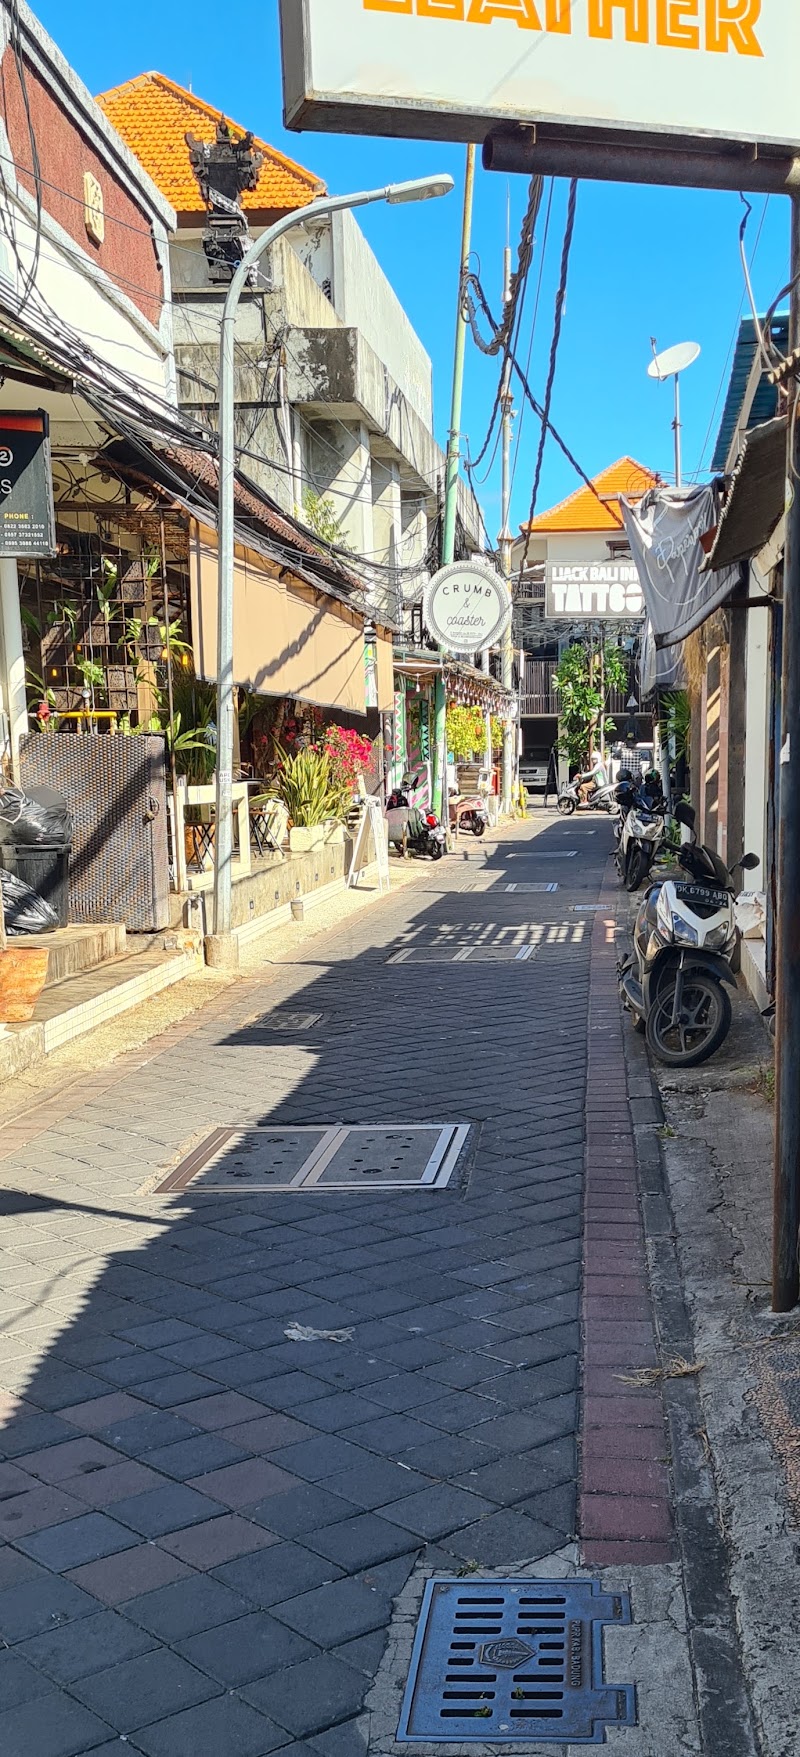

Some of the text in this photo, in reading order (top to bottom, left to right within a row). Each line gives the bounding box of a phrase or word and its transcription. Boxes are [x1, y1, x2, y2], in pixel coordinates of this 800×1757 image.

[361, 0, 765, 58] ATHER
[442, 584, 492, 598] CRUMB
[552, 583, 642, 612] TATTOO
[463, 597, 470, 608] &
[446, 614, 486, 627] coaster
[677, 885, 687, 893] DK
[690, 887, 710, 897] 6799
[571, 1655, 581, 1686] BADUNG
